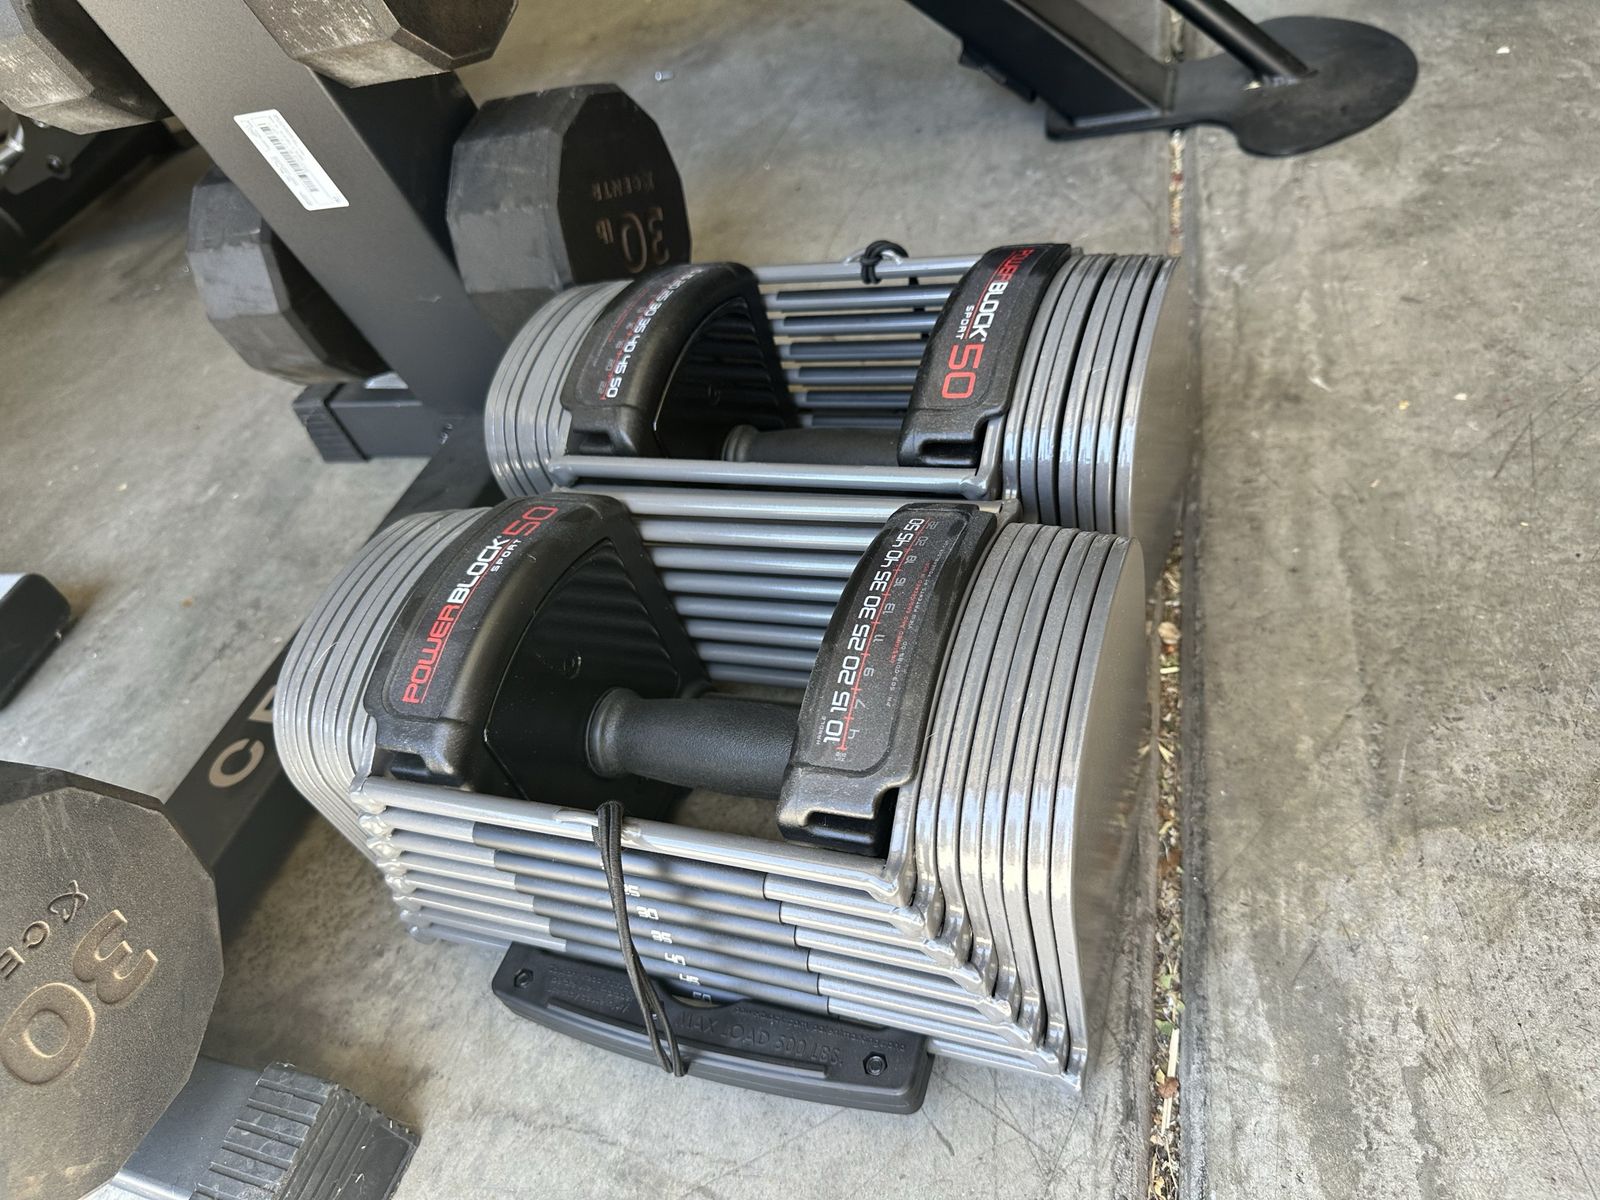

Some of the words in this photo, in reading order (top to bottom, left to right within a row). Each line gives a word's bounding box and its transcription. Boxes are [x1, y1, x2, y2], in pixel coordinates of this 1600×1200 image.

[644, 302, 662, 317] 30
[634, 318, 651, 334] 35
[955, 305, 975, 340] SPORT
[624, 335, 640, 353] 40
[615, 355, 631, 375] 45
[941, 344, 985, 399] 50
[606, 377, 622, 398] 50
[903, 518, 925, 532] 50
[892, 532, 913, 549] 45
[491, 539, 521, 572] SPORT
[880, 550, 903, 569] 40
[870, 571, 892, 592] 35
[402, 535, 511, 704] POWERBLOCK
[502, 506, 559, 537] 50
[858, 595, 881, 620] 30
[848, 623, 870, 651] 25
[837, 656, 860, 686] 20
[848, 728, 860, 740] 4
[855, 699, 867, 710] 7
[863, 667, 875, 678] 9
[873, 633, 885, 643] 11
[883, 603, 896, 615] 13
[830, 691, 851, 713] 15
[815, 715, 828, 746] HANDLE
[823, 719, 844, 744] 10
[636, 906, 659, 920] 30
[651, 930, 672, 944] 35
[665, 952, 686, 966] 40
[0, 909, 159, 1085] 30
